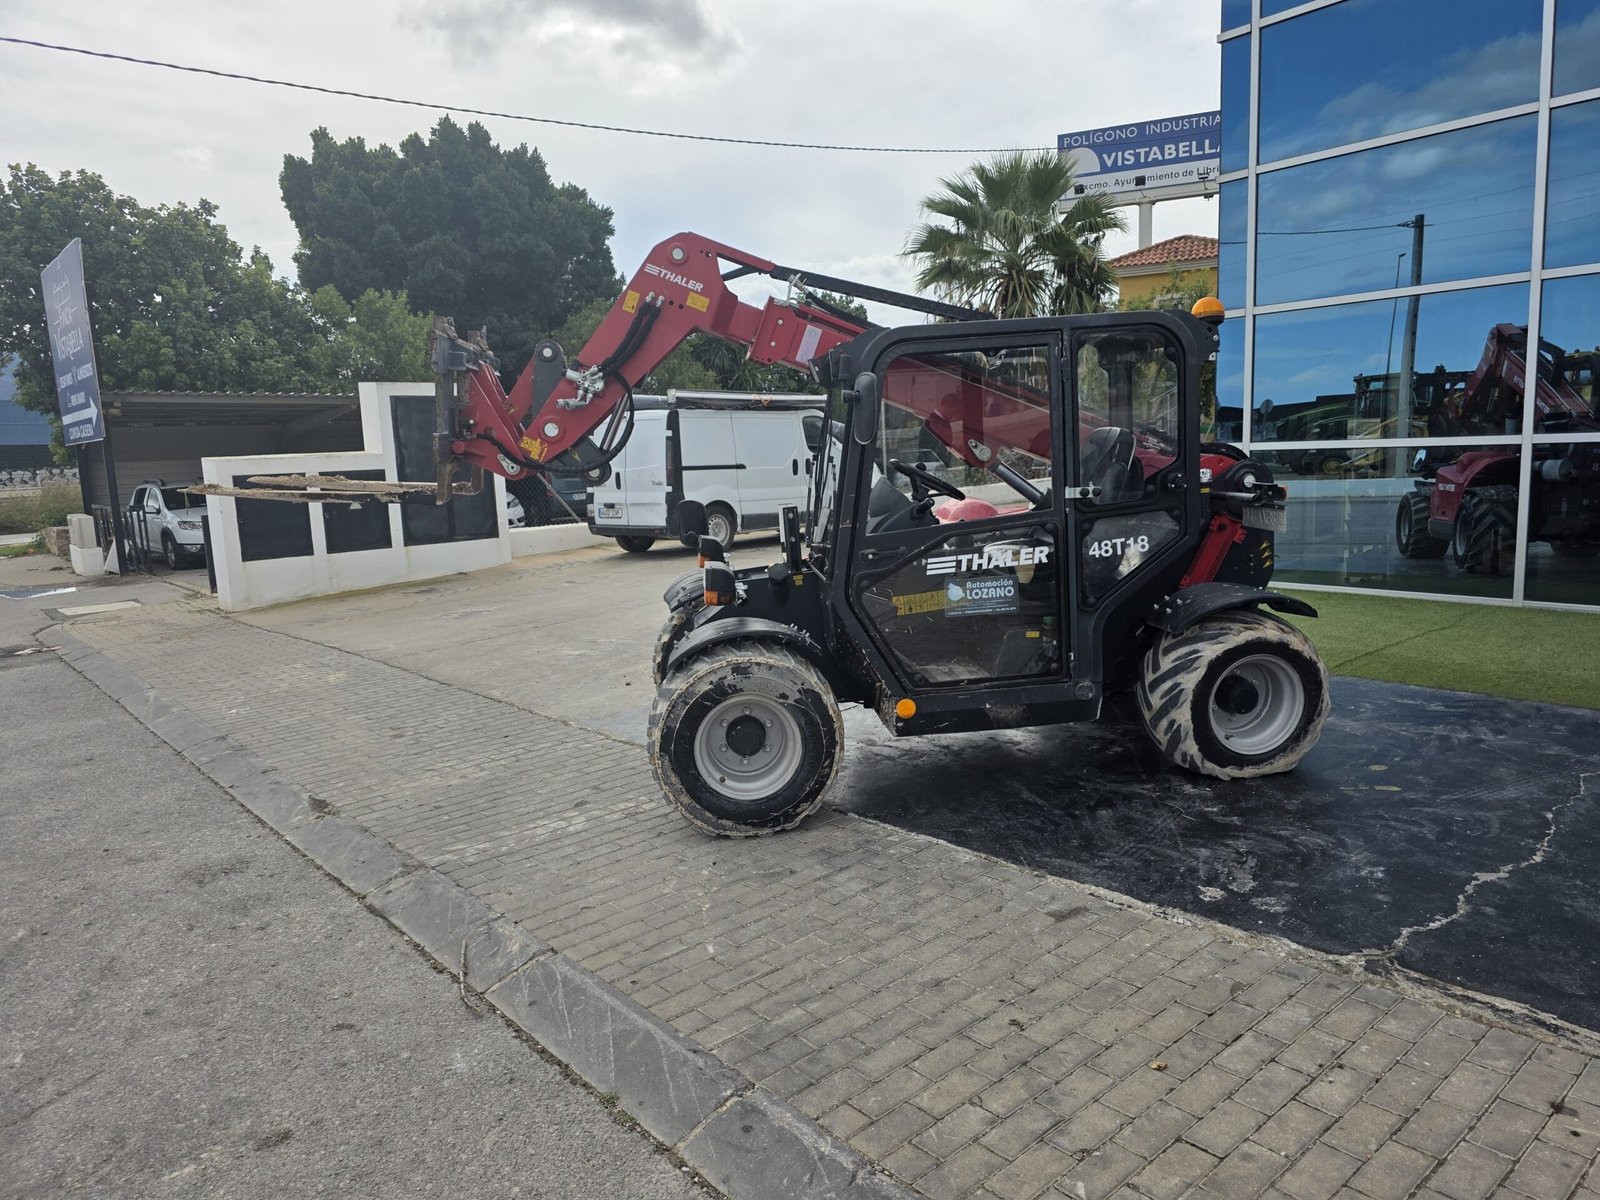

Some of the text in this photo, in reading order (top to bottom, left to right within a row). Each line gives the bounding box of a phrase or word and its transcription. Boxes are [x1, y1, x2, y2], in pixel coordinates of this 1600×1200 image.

[1063, 127, 1138, 148] POLÍGONO
[1102, 138, 1220, 168] VISTABELL
[1080, 181, 1111, 191] xcmo.
[1182, 169, 1194, 177] de
[660, 268, 704, 292] THALER
[1088, 535, 1150, 558] 48T18
[957, 546, 1049, 572] THALER
[966, 578, 1013, 589] Automoción
[966, 586, 1015, 600] LOZANO
